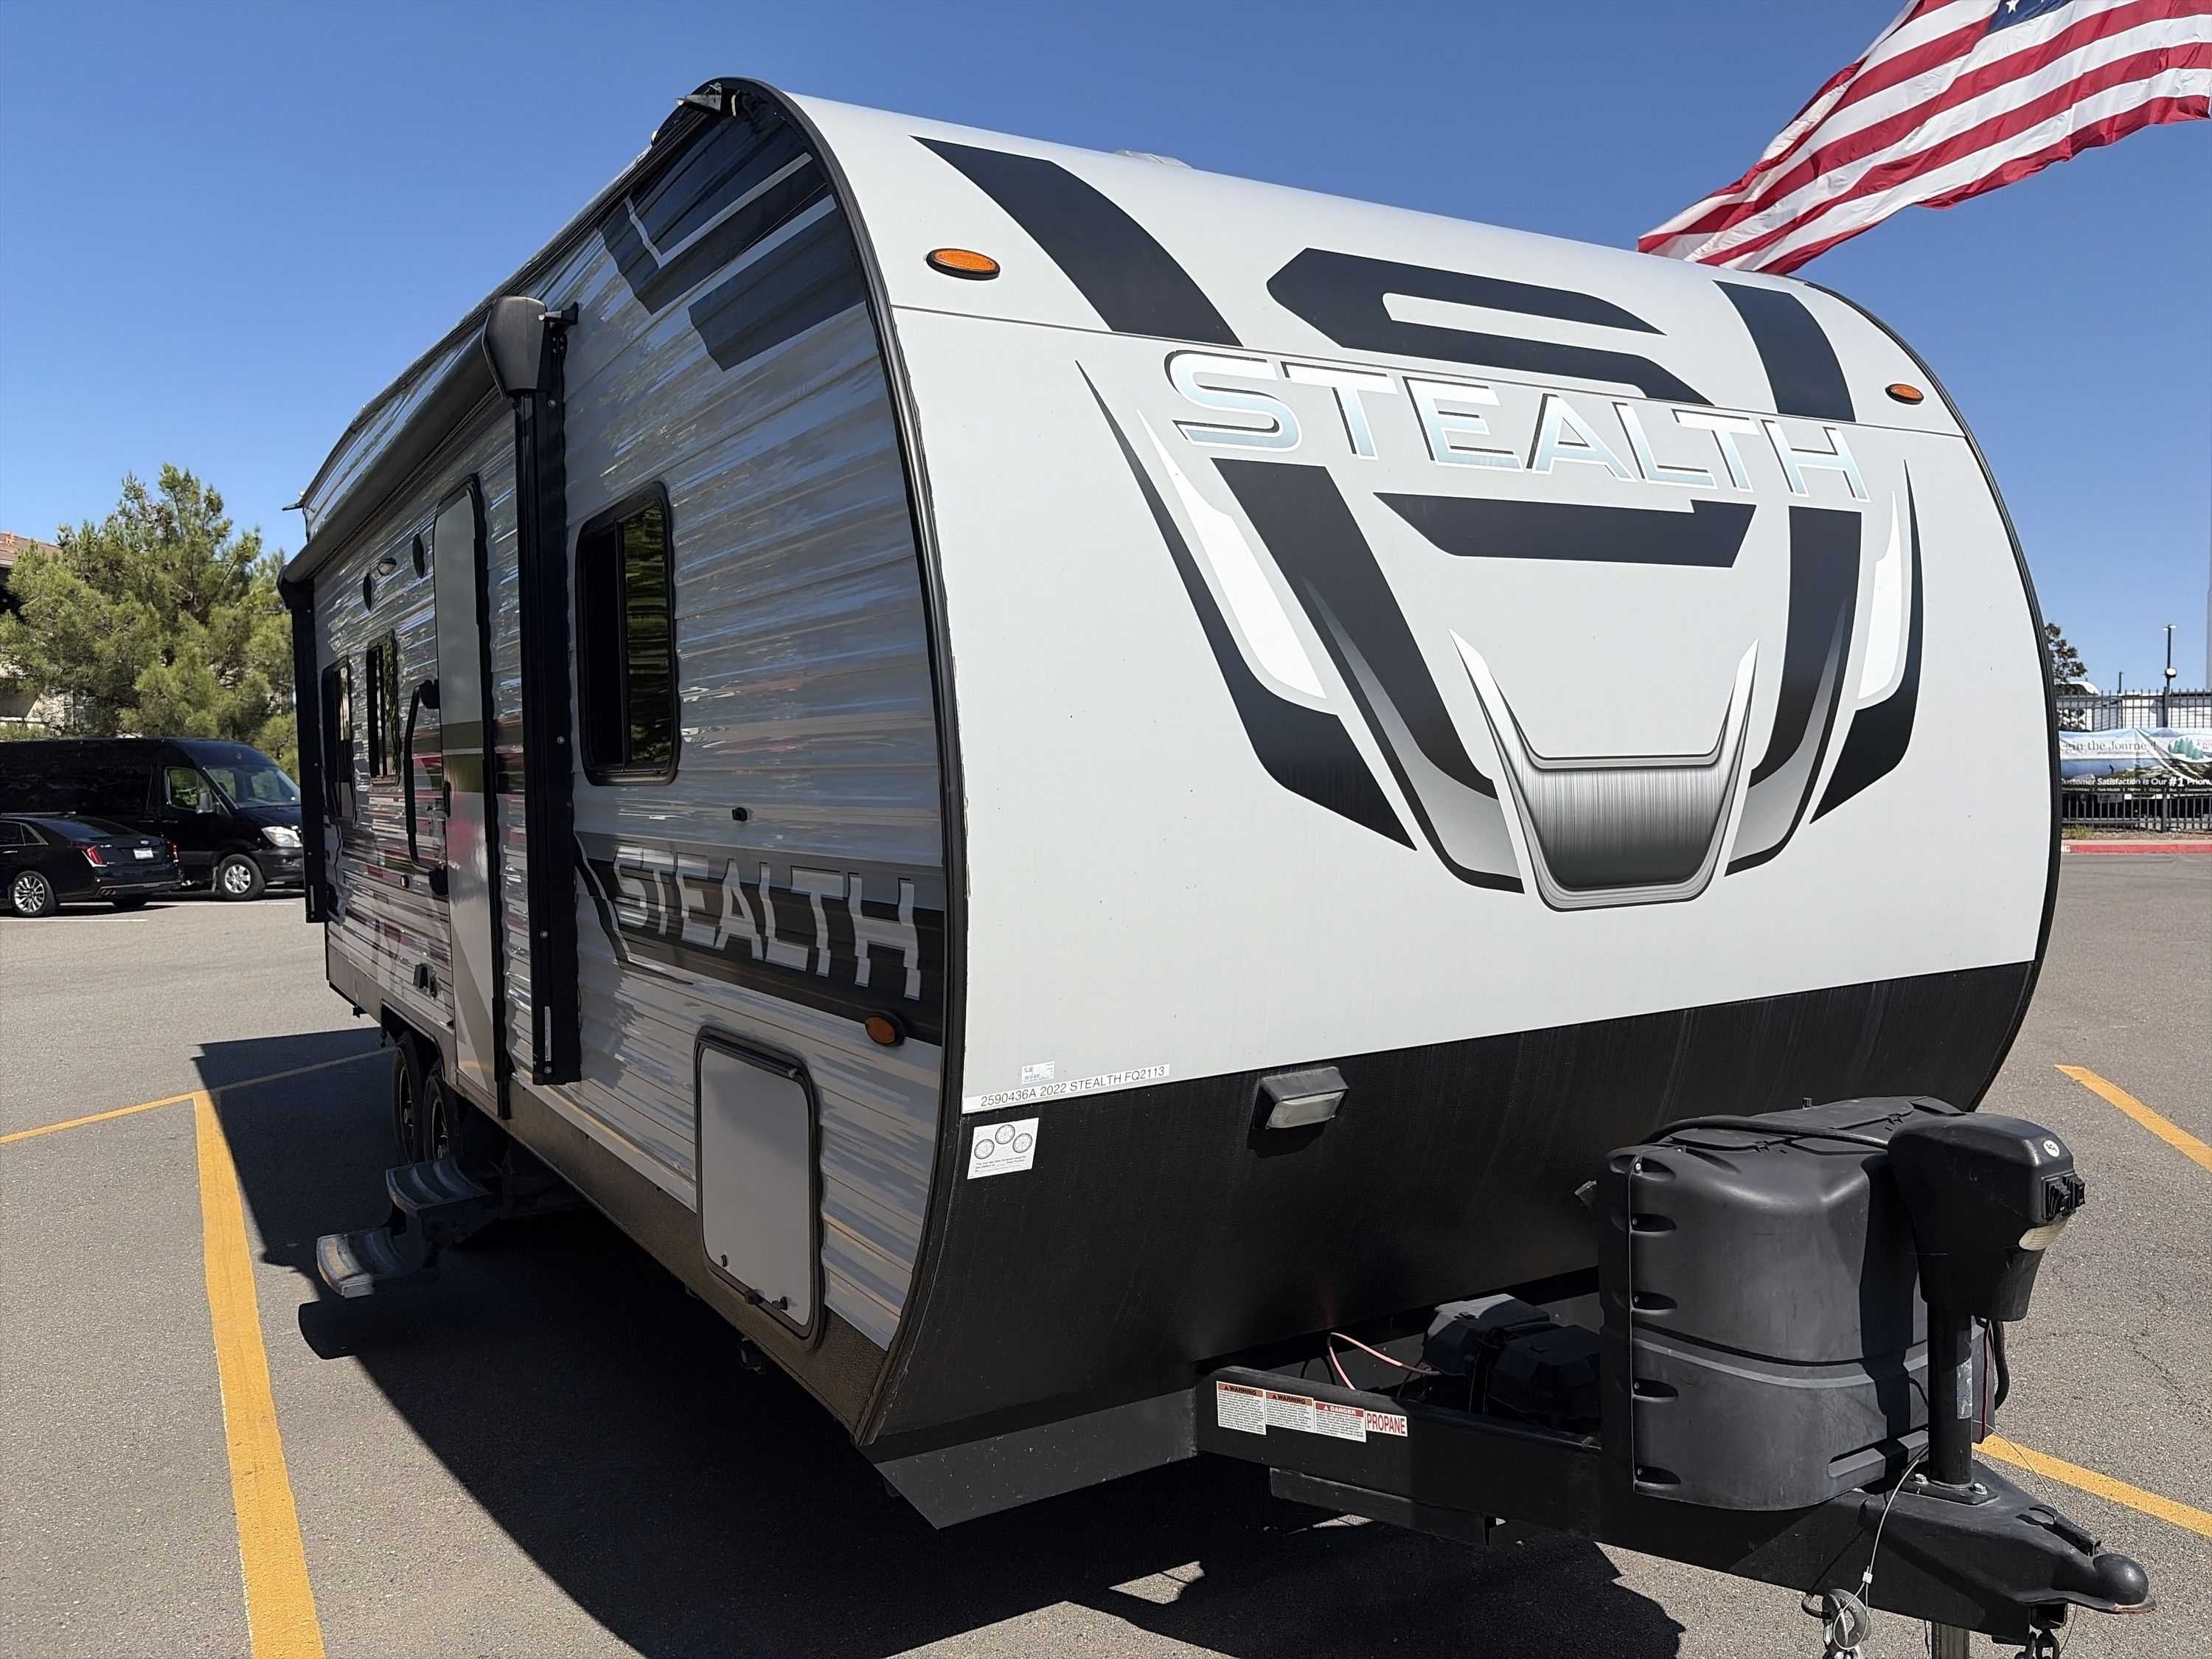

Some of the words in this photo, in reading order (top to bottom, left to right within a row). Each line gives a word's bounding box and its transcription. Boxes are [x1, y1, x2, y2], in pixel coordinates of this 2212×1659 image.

[1164, 351, 1871, 503] STEALTH
[2087, 740, 2105, 750] the
[2097, 777, 2141, 786] Satisfaction
[2151, 777, 2168, 785] Our
[2168, 776, 2185, 787] #1
[613, 845, 922, 1001] STEALTH
[981, 1088, 1037, 1107] 2590436A
[1040, 1082, 1067, 1098] 2022
[1070, 1074, 1121, 1092] STEALTH
[1124, 1065, 1165, 1082] FQ2113
[1329, 1405, 1357, 1416] DANGER
[1366, 1413, 1405, 1435] PROPANE
